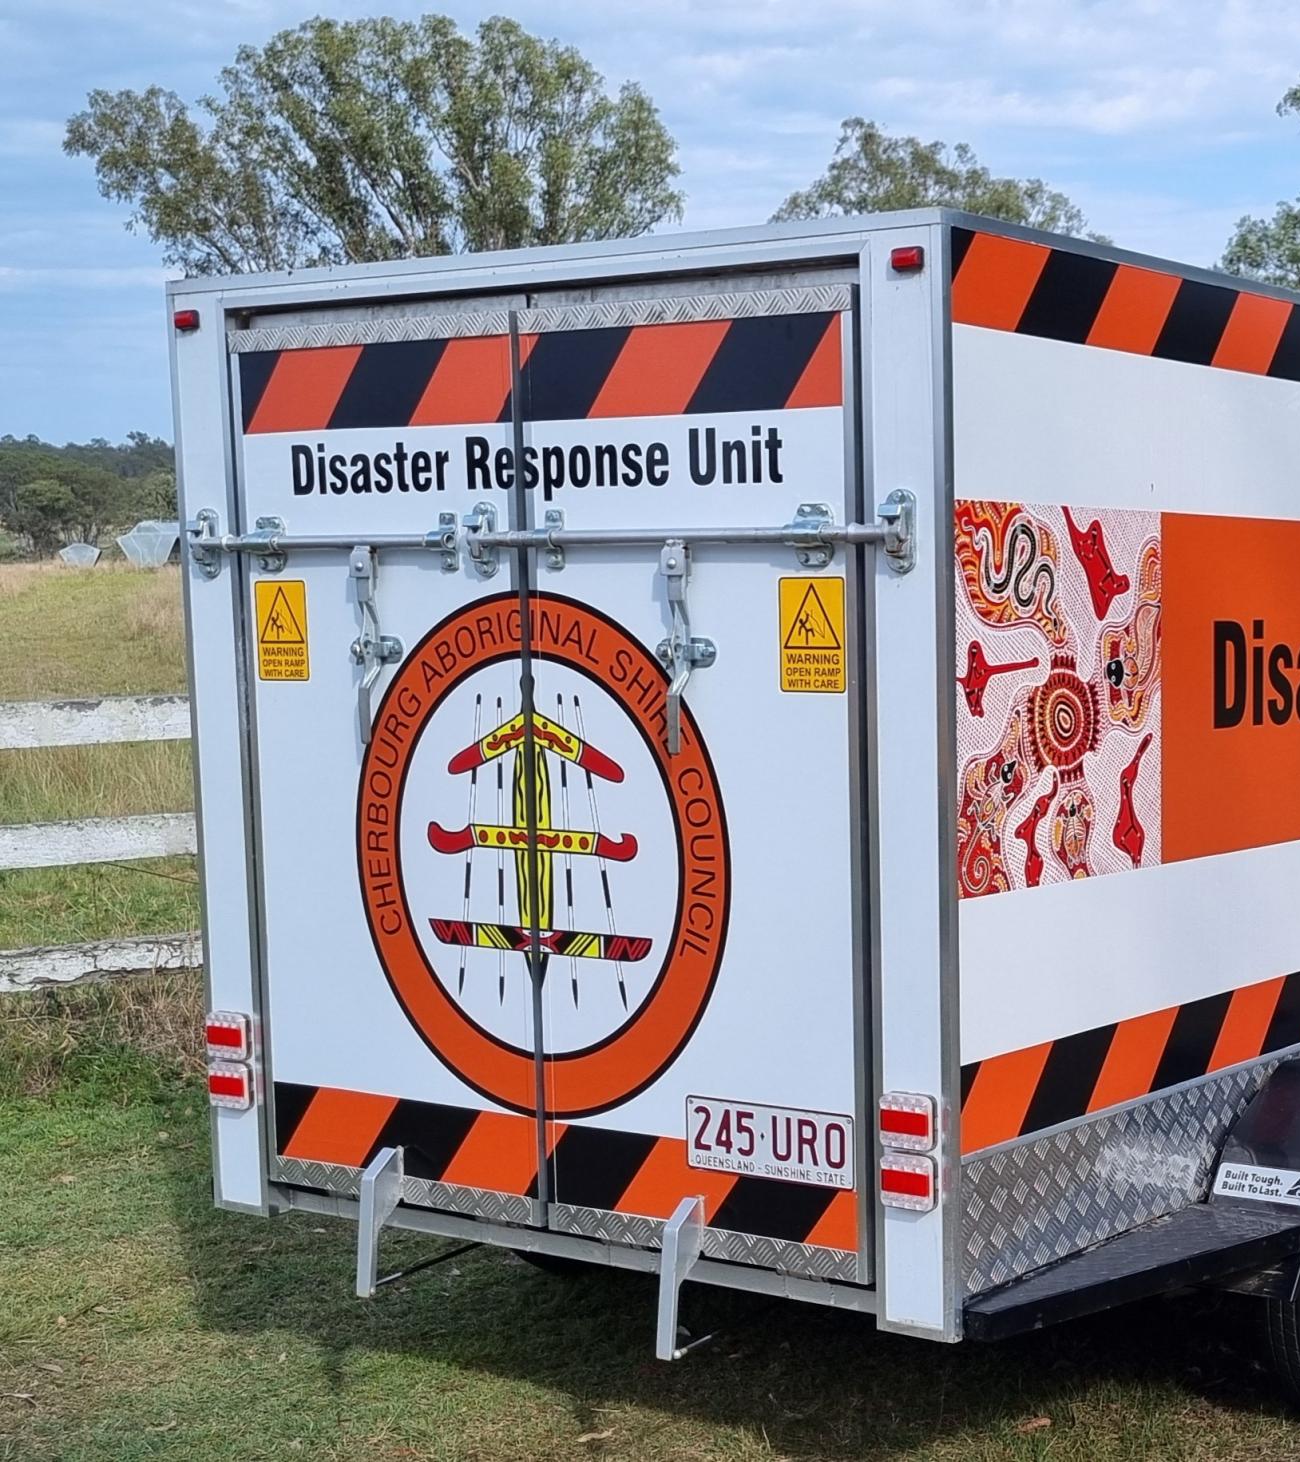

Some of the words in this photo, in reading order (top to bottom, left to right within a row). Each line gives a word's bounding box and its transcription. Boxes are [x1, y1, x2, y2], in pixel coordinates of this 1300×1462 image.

[292, 441, 450, 495] Disaster
[465, 436, 670, 501] Response
[688, 425, 784, 486] Unit
[262, 647, 304, 657] WARNING
[262, 659, 282, 668] OPEN
[284, 659, 306, 668] RAMP
[786, 653, 840, 665] WARNING
[265, 669, 283, 678] WITH
[284, 669, 304, 678] CARE
[785, 667, 811, 677] OPEN
[814, 668, 842, 677] RAMP
[787, 679, 811, 689] WITH
[813, 679, 839, 689] CARE
[367, 686, 422, 936] CHERBOURG
[421, 609, 600, 693] ABORIGINAL
[676, 766, 716, 957] COUNCIL
[695, 1155, 755, 1173] QUEENSLAND
[765, 1165, 812, 1181] SUNSHINE
[817, 1171, 846, 1186] STATE
[1225, 1170, 1249, 1182] Built
[1251, 1173, 1283, 1186] Tough.
[1221, 1181, 1246, 1194] Built
[1248, 1184, 1259, 1195] To
[1259, 1186, 1283, 1198] Last.
